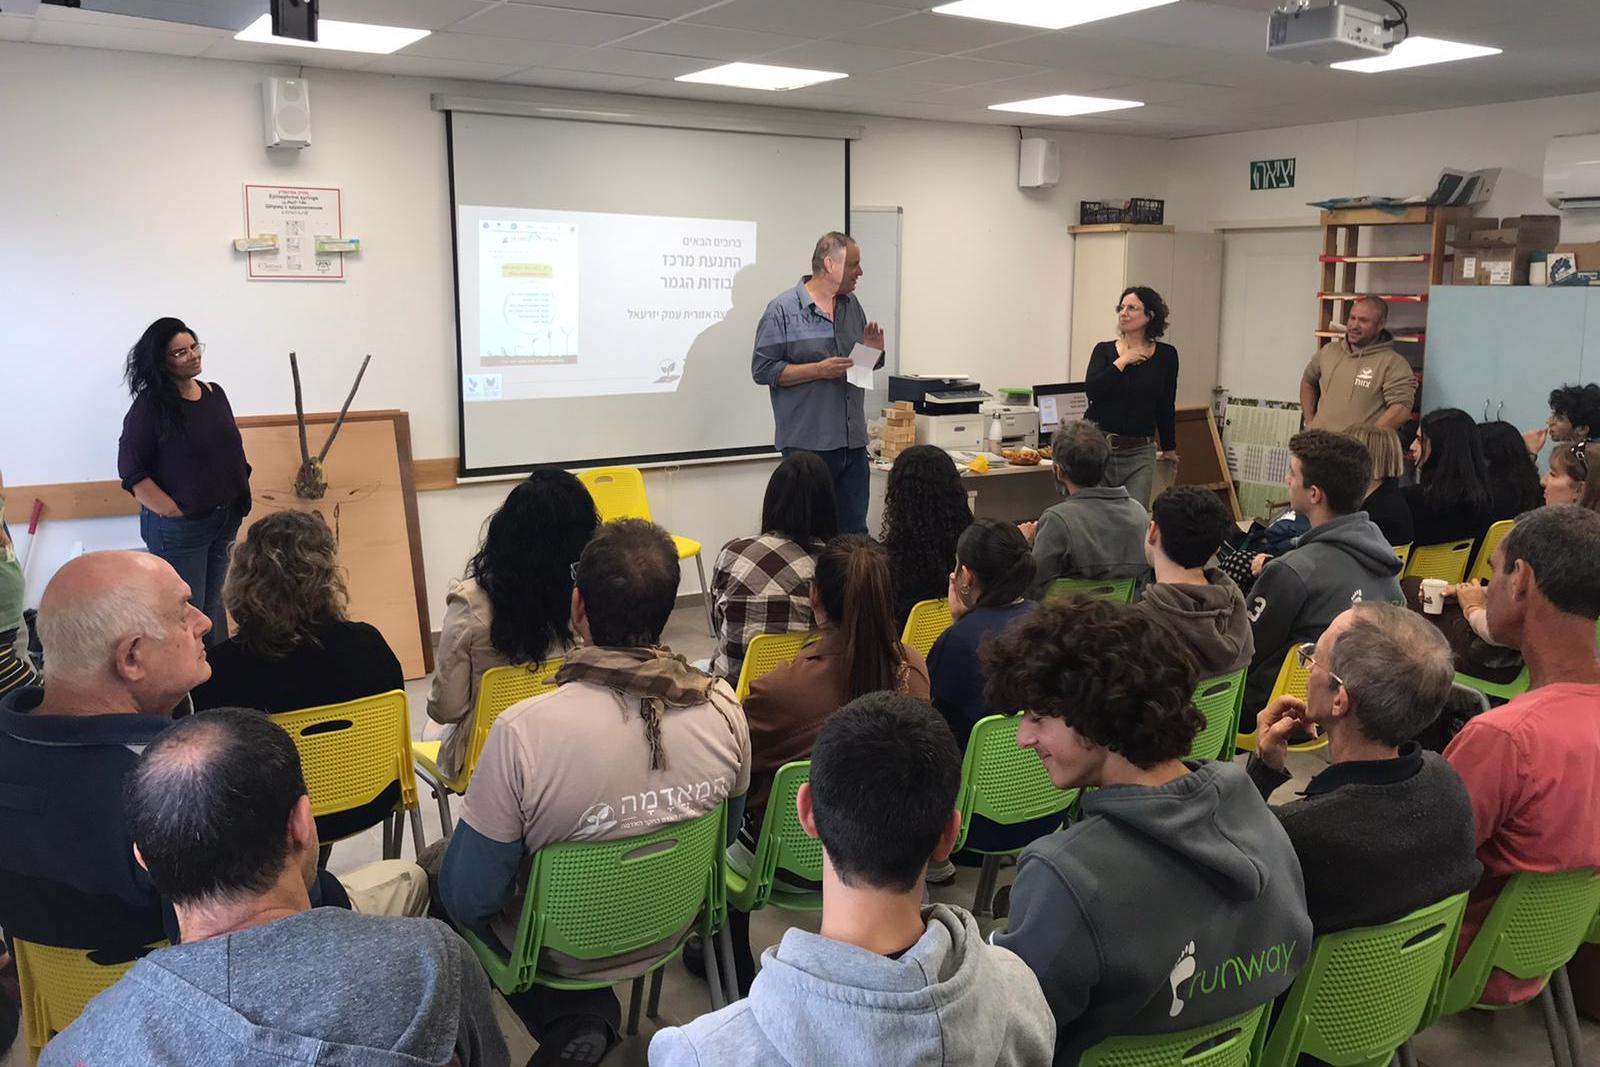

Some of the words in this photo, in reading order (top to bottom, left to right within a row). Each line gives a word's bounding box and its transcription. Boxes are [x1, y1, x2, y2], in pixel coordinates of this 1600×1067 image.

[1254, 159, 1294, 190] יציאה
[682, 237, 712, 247] הבאים
[714, 238, 742, 248] ברוכים
[662, 254, 695, 267] מרכז
[699, 255, 741, 268] התנעת
[660, 277, 694, 289] הגמר
[698, 278, 732, 289] בודות
[627, 308, 660, 320] יזרעאל
[661, 310, 681, 321] עמק
[683, 310, 714, 320] אזורית
[1189, 940, 1297, 999] runway
